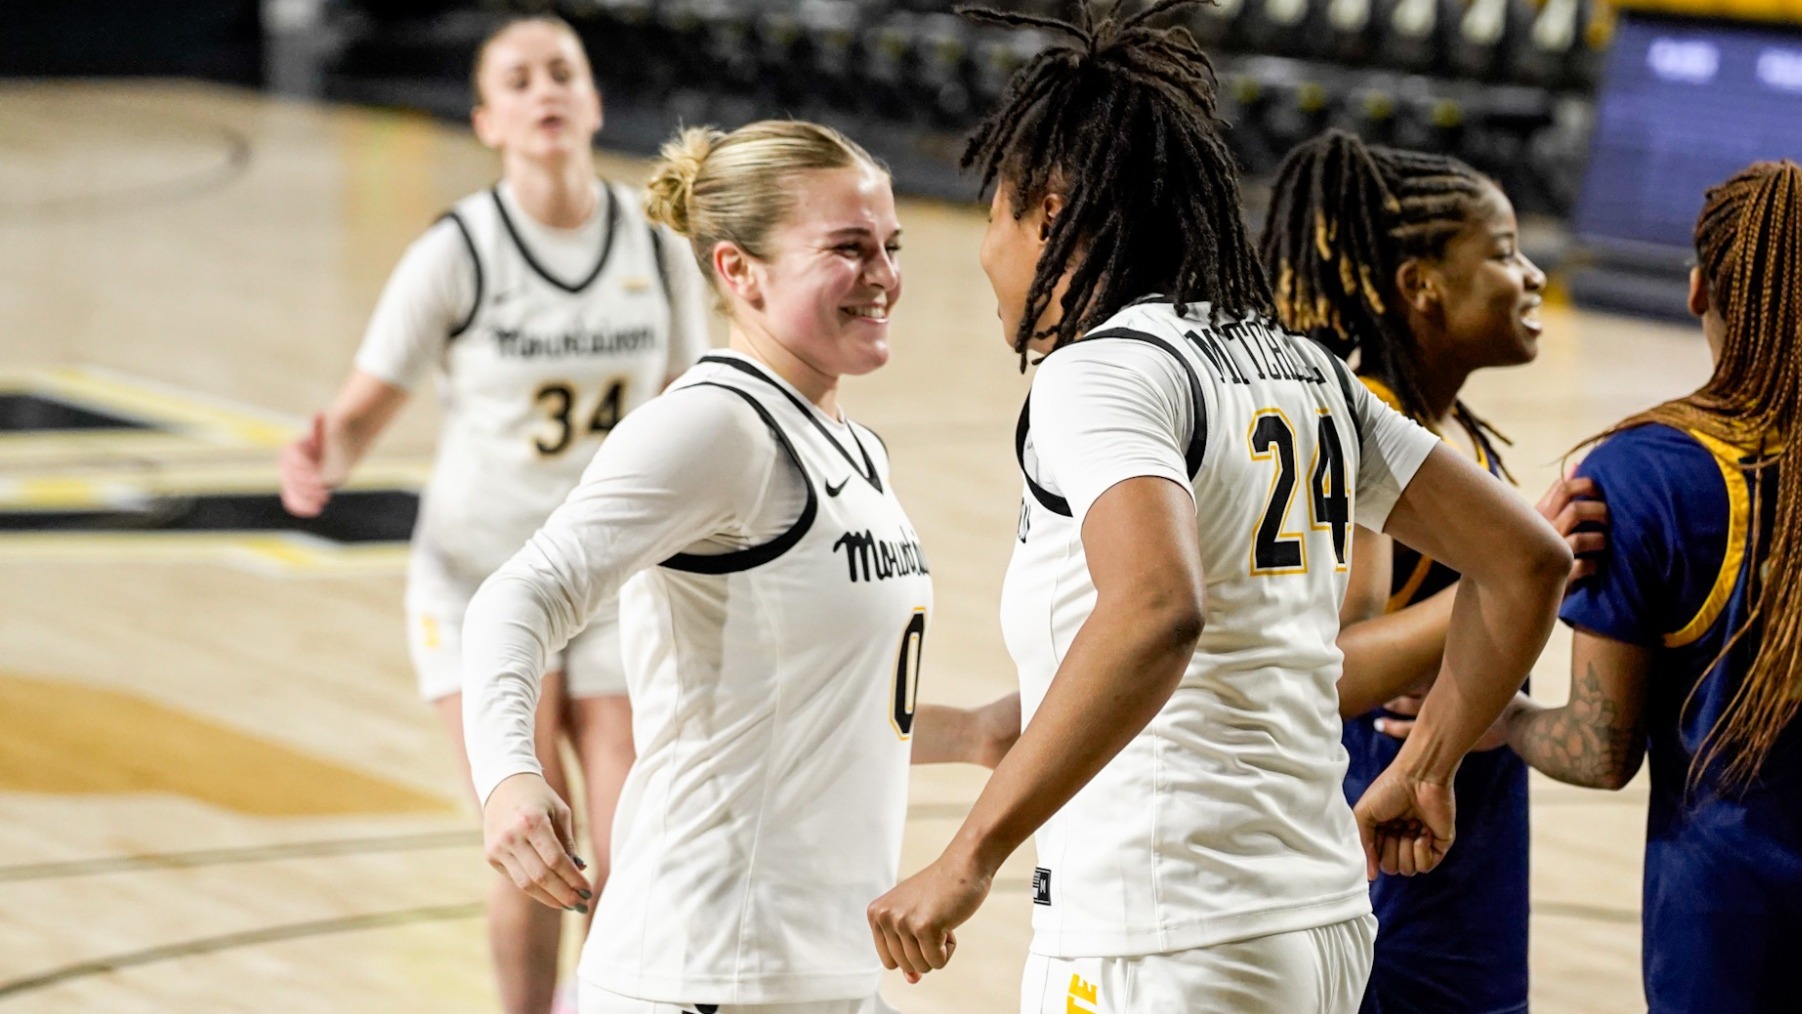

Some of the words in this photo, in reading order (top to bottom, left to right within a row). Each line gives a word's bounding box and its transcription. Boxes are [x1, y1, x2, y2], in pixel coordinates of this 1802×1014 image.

[1184, 321, 1327, 385] MITCHL
[534, 378, 627, 457] 34
[1248, 408, 1352, 576] 24
[889, 606, 926, 742] 0
